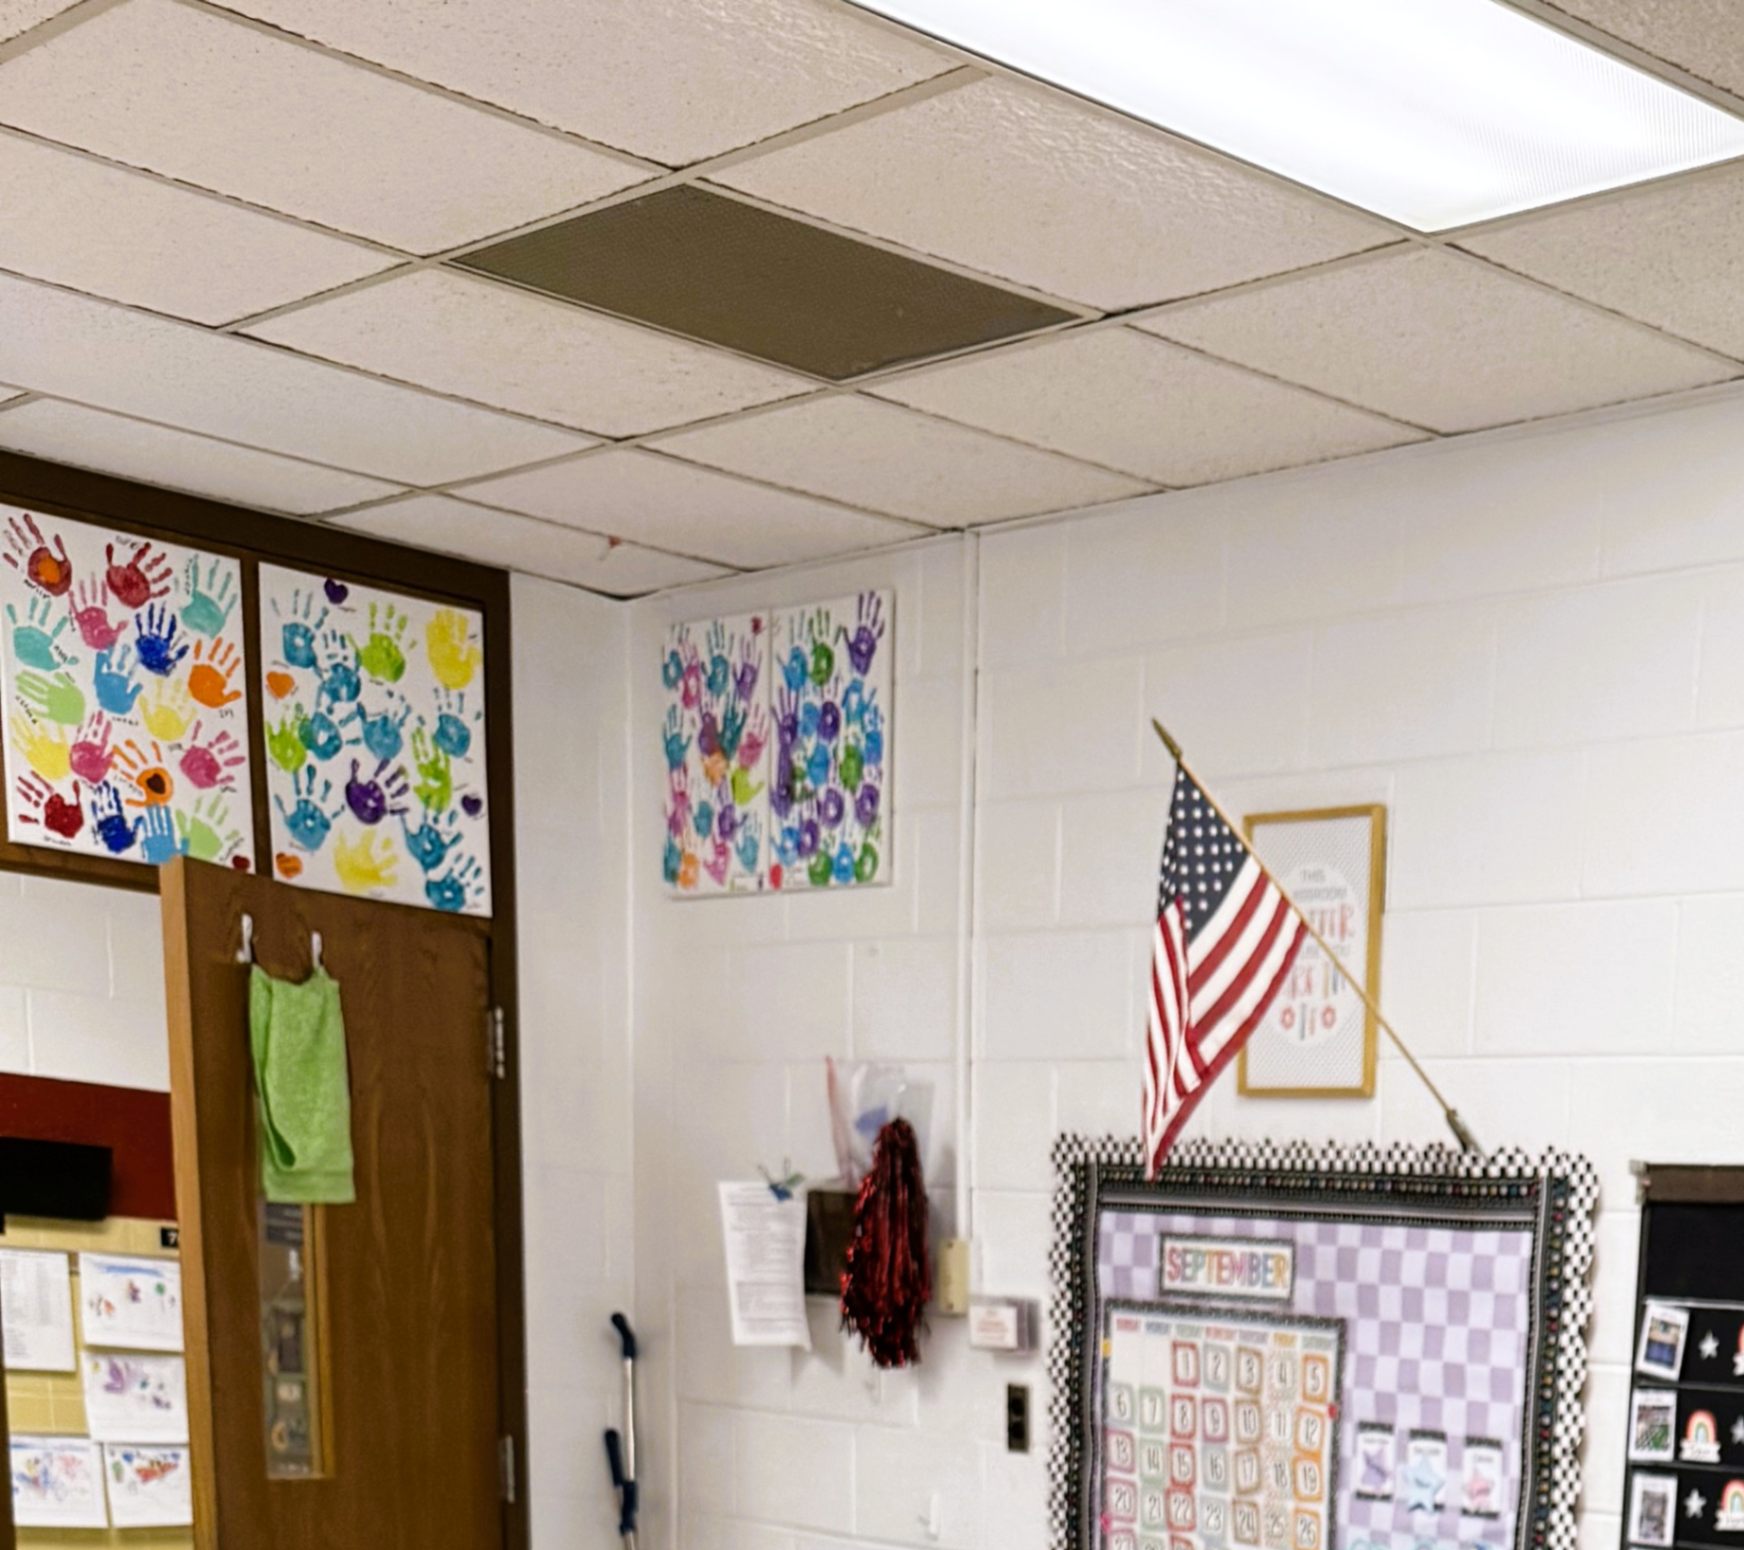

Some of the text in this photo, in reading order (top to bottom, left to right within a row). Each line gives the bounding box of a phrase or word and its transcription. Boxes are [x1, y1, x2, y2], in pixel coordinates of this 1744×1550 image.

[1167, 1246, 1289, 1288] SEPTEMBER
[1213, 1351, 1222, 1381] 2
[1245, 1355, 1255, 1386] 3
[1310, 1363, 1321, 1393] 5
[1116, 1391, 1127, 1418] 6
[1149, 1398, 1159, 1424] 7
[1179, 1402, 1188, 1430] 8
[1210, 1405, 1221, 1432] 9
[1243, 1403, 1258, 1433] 10
[1304, 1414, 1319, 1443] 12
[1114, 1435, 1129, 1463] 13
[1146, 1448, 1160, 1472] 14
[1175, 1444, 1190, 1474] 15
[1208, 1454, 1223, 1480] 16
[1273, 1460, 1288, 1488] 18
[1301, 1464, 1317, 1492] 19
[1114, 1483, 1131, 1510] 20
[1148, 1494, 1162, 1520] 21
[1174, 1489, 1191, 1517] 22
[1205, 1502, 1222, 1531] 23
[1238, 1508, 1256, 1537] 24
[1299, 1516, 1316, 1544] 26
